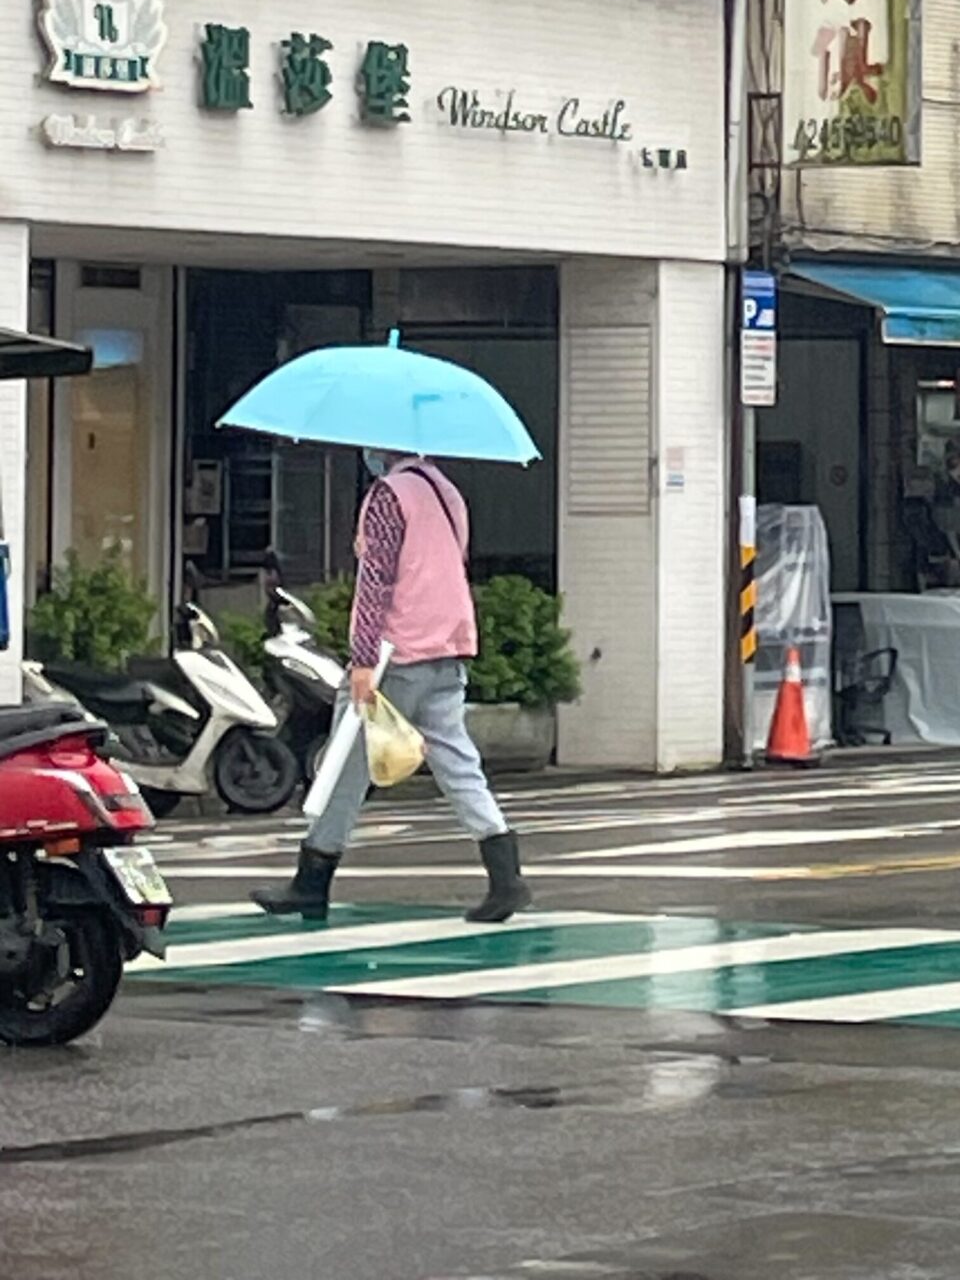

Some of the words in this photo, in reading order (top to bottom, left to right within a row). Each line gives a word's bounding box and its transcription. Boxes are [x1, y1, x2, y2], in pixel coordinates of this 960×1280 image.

[202, 22, 412, 122] 溫莎堡
[436, 86, 548, 134] Windsor
[556, 97, 633, 142] Castle
